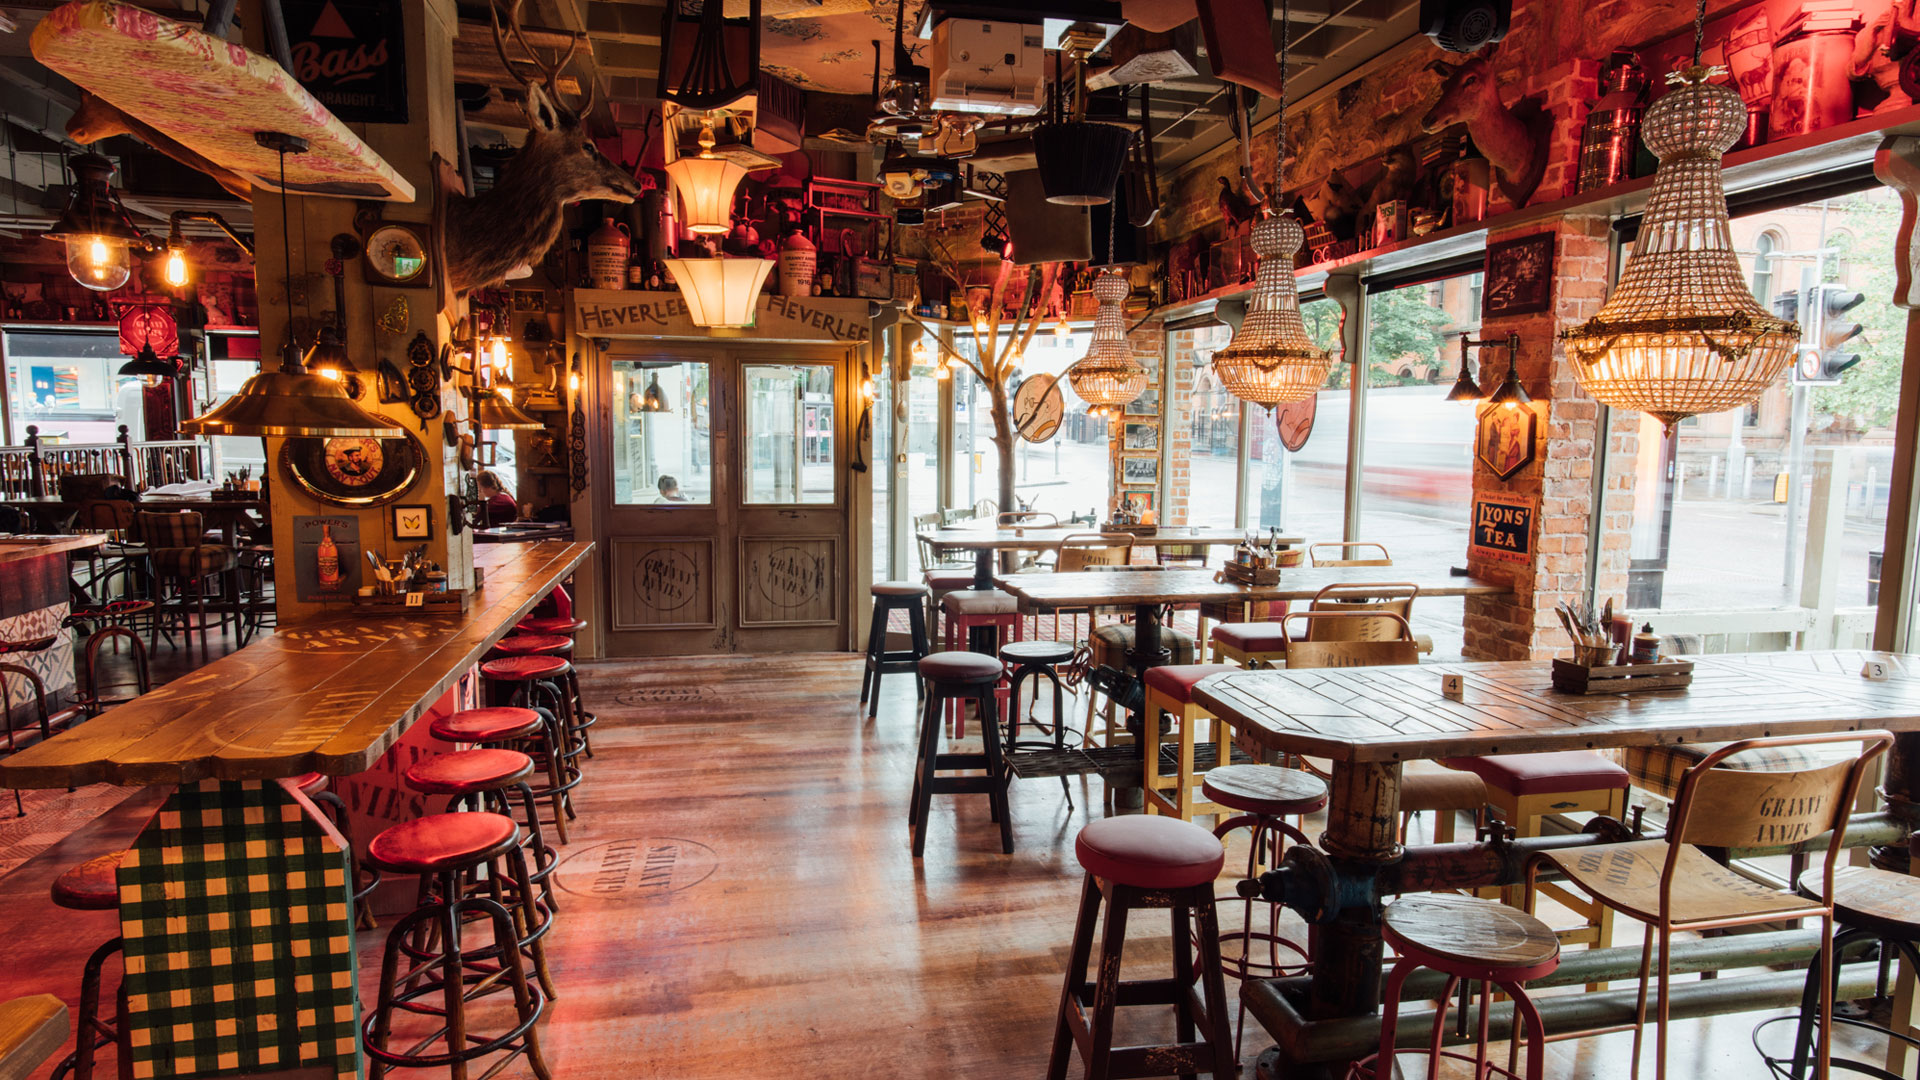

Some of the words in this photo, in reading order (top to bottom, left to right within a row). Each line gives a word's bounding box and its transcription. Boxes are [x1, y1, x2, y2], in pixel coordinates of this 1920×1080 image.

[290, 38, 388, 82] Bass
[580, 299, 689, 330] HEVERLEE
[766, 295, 869, 341] HEVERLEE
[303, 519, 349, 529] POWER'S
[1478, 503, 1530, 528] LYONS'
[1484, 527, 1517, 548] TEA
[410, 594, 419, 604] 11
[1873, 664, 1883, 677] 3
[1447, 678, 1458, 690] 4
[592, 845, 637, 893] GRANNY
[638, 845, 678, 889] ANNIES
